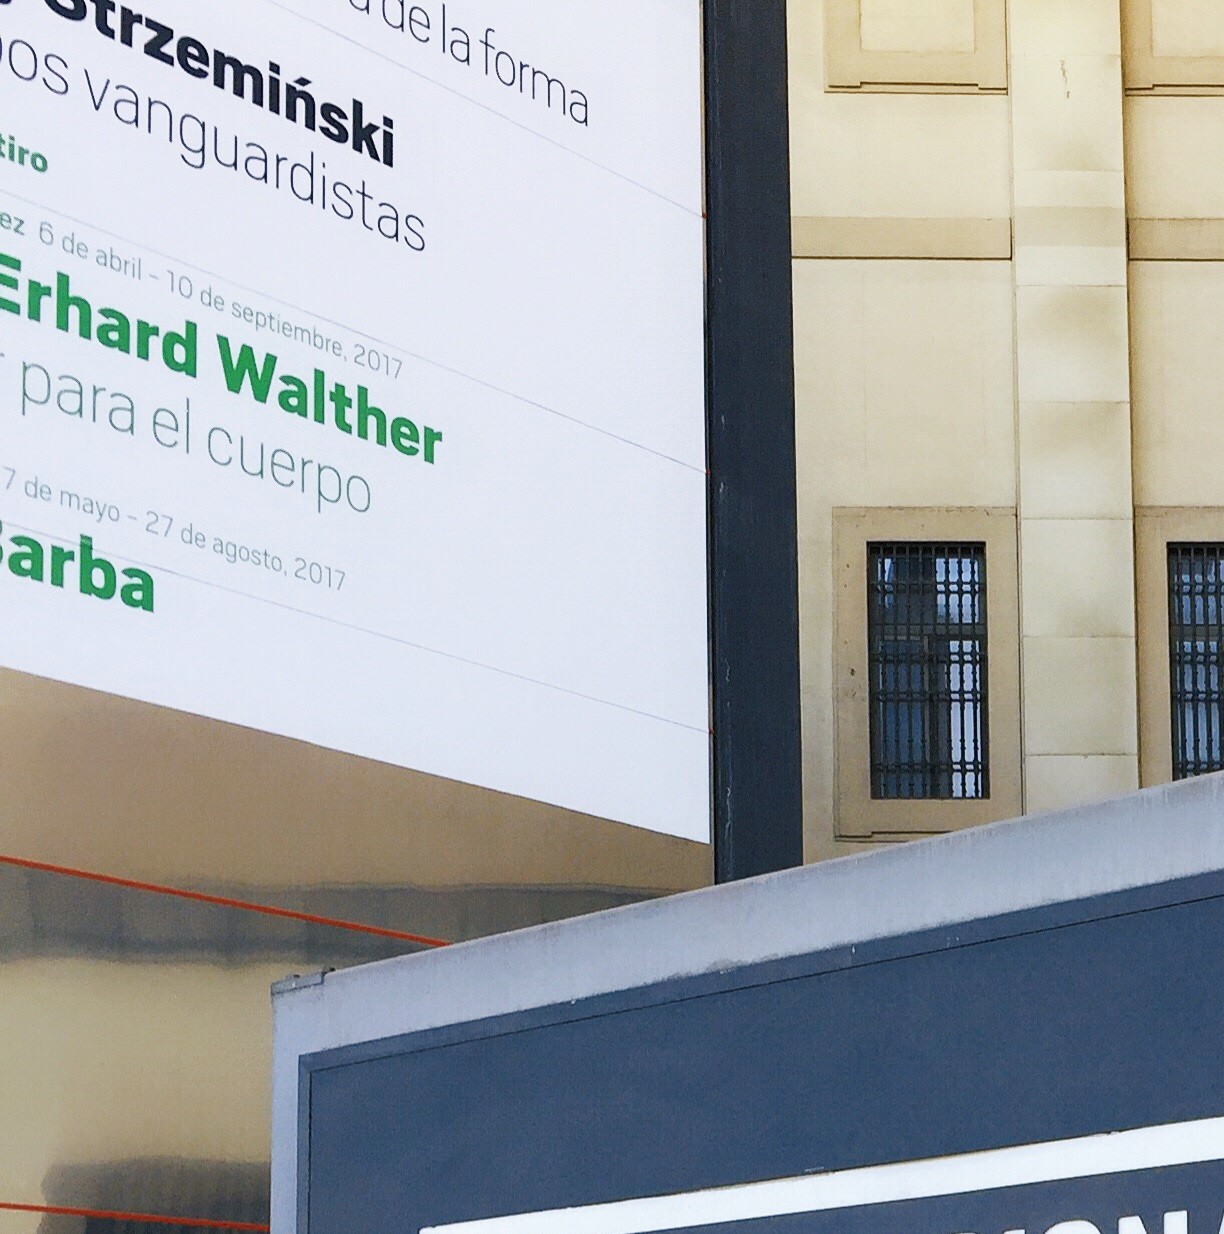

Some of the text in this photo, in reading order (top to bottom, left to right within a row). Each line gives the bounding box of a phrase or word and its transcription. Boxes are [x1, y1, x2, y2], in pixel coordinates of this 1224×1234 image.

[381, 0, 588, 128] de la forma
[0, 36, 426, 252] os vanguardistas
[39, 221, 55, 247] 6
[61, 231, 89, 259] de
[95, 246, 142, 281] abril
[167, 269, 194, 300] 10
[200, 285, 226, 313] de
[231, 301, 348, 362] septiembre,
[353, 342, 404, 380] 2017
[21, 361, 372, 514] para el cuerpo
[215, 333, 443, 465] Walther
[0, 519, 154, 614] arba
[3, 465, 17, 491] 7
[23, 475, 52, 502] de
[60, 489, 121, 524] mayo
[145, 510, 174, 538] 27
[180, 523, 207, 550] de
[211, 536, 288, 577] agosto,
[294, 557, 347, 591] 2017
